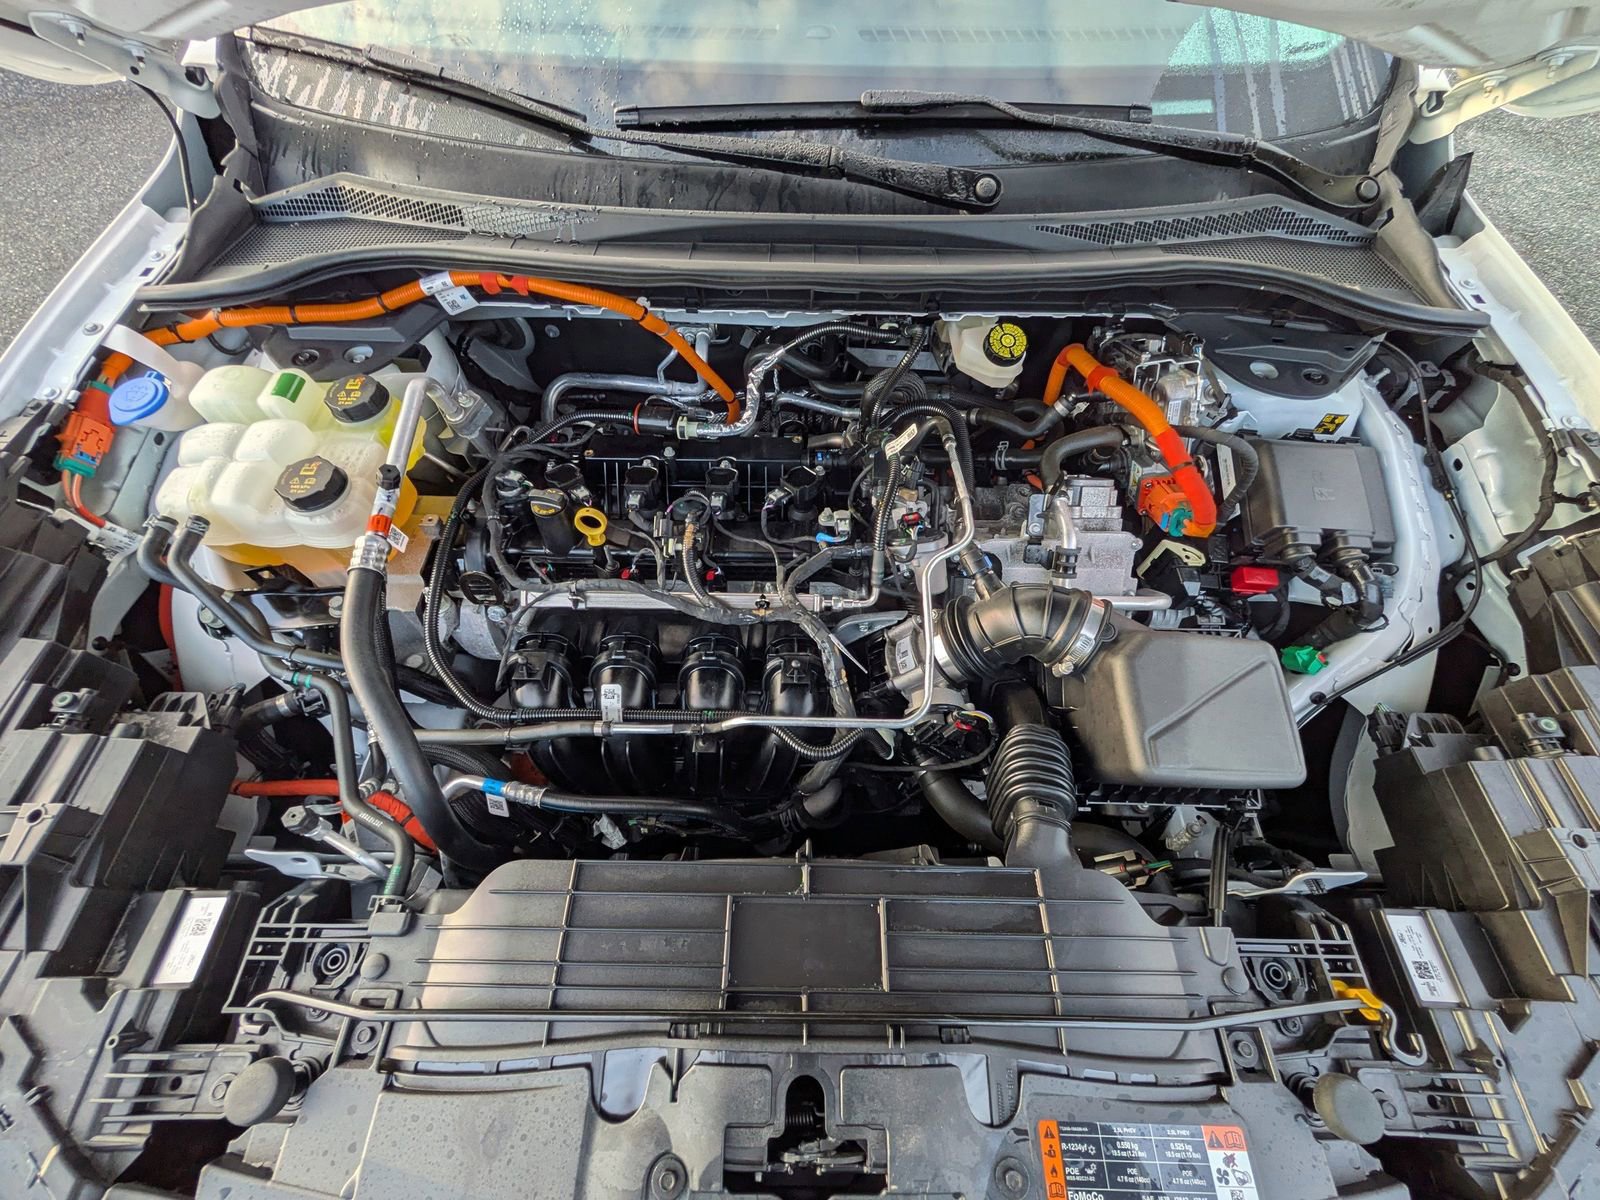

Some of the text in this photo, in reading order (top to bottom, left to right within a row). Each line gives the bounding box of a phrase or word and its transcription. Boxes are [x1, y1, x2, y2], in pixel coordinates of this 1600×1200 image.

[1061, 1142, 1088, 1152] R-1234yf
[1065, 1167, 1080, 1175] POE
[1126, 1167, 1138, 1175] POE
[1067, 1190, 1104, 1200] FoMoCo
